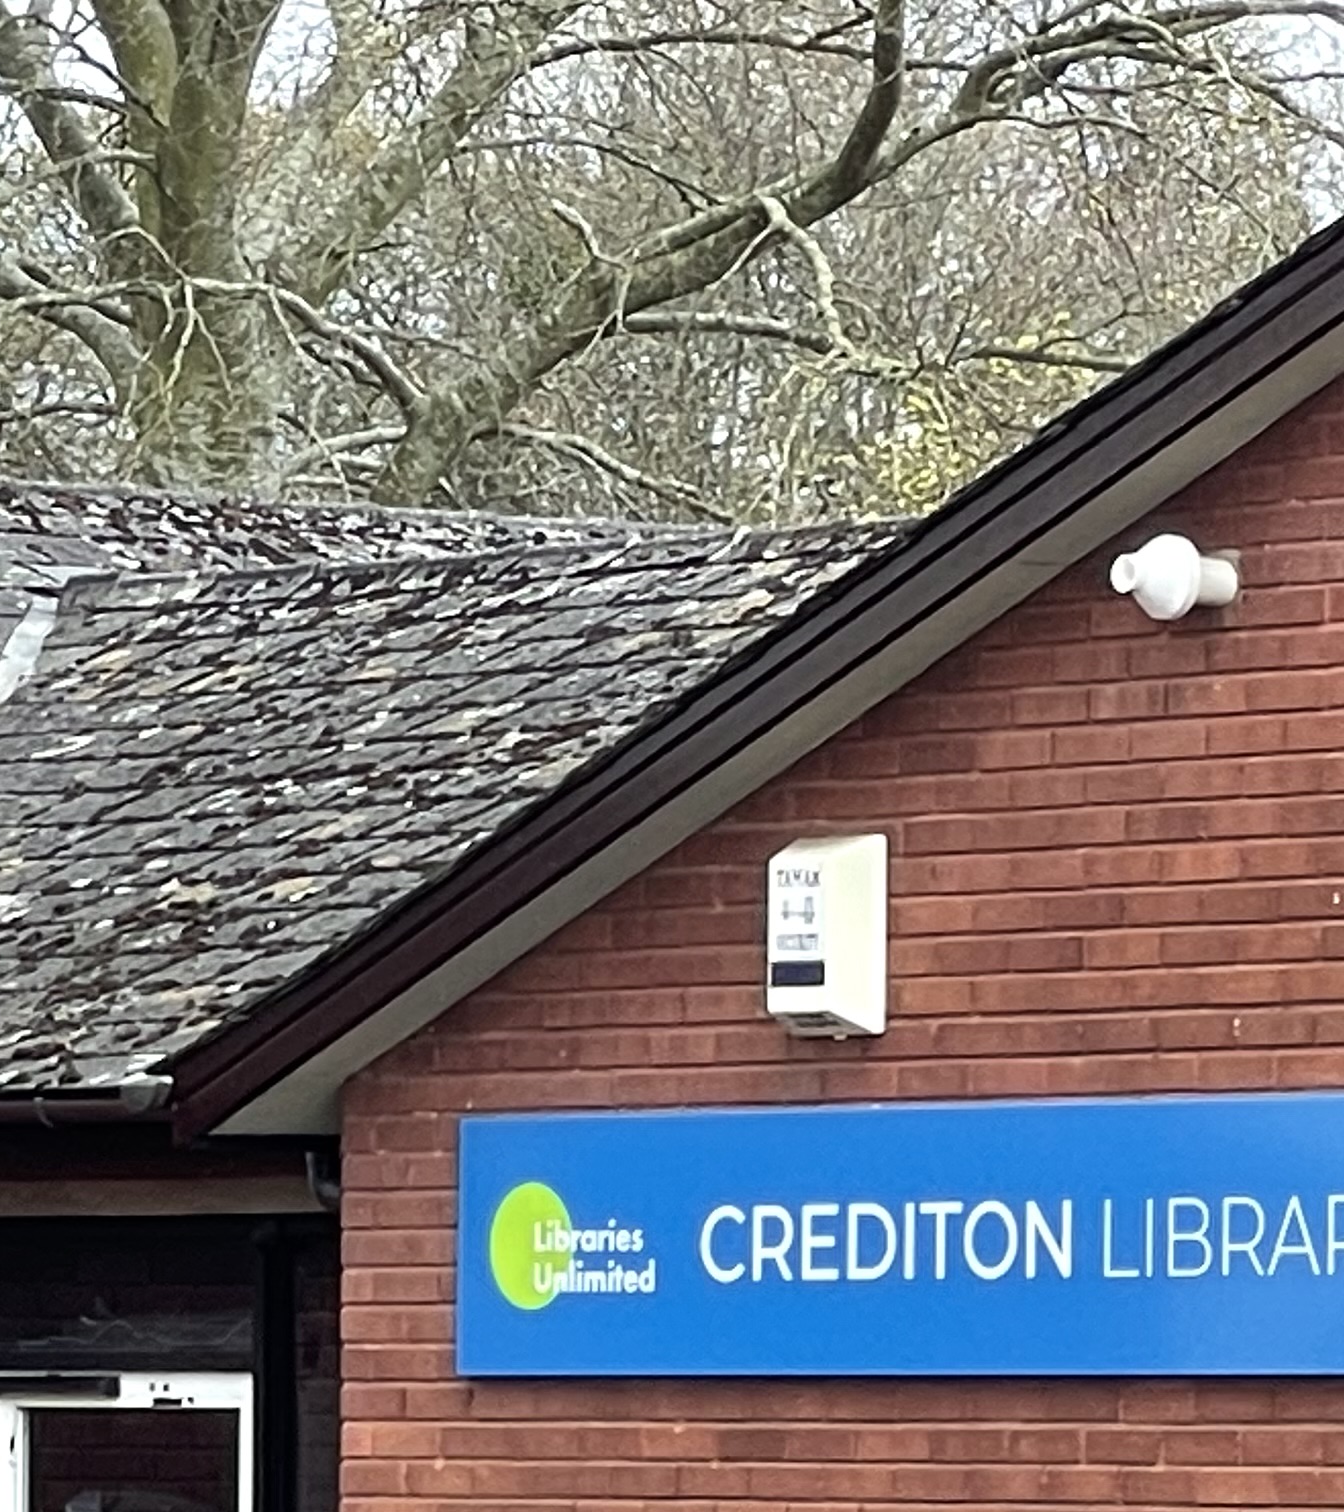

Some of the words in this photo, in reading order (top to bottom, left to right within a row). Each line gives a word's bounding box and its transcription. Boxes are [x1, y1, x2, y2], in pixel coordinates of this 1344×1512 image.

[533, 1218, 644, 1253] Libraries
[699, 1200, 1072, 1284] CREDITON
[533, 1258, 655, 1293] Unlimited
